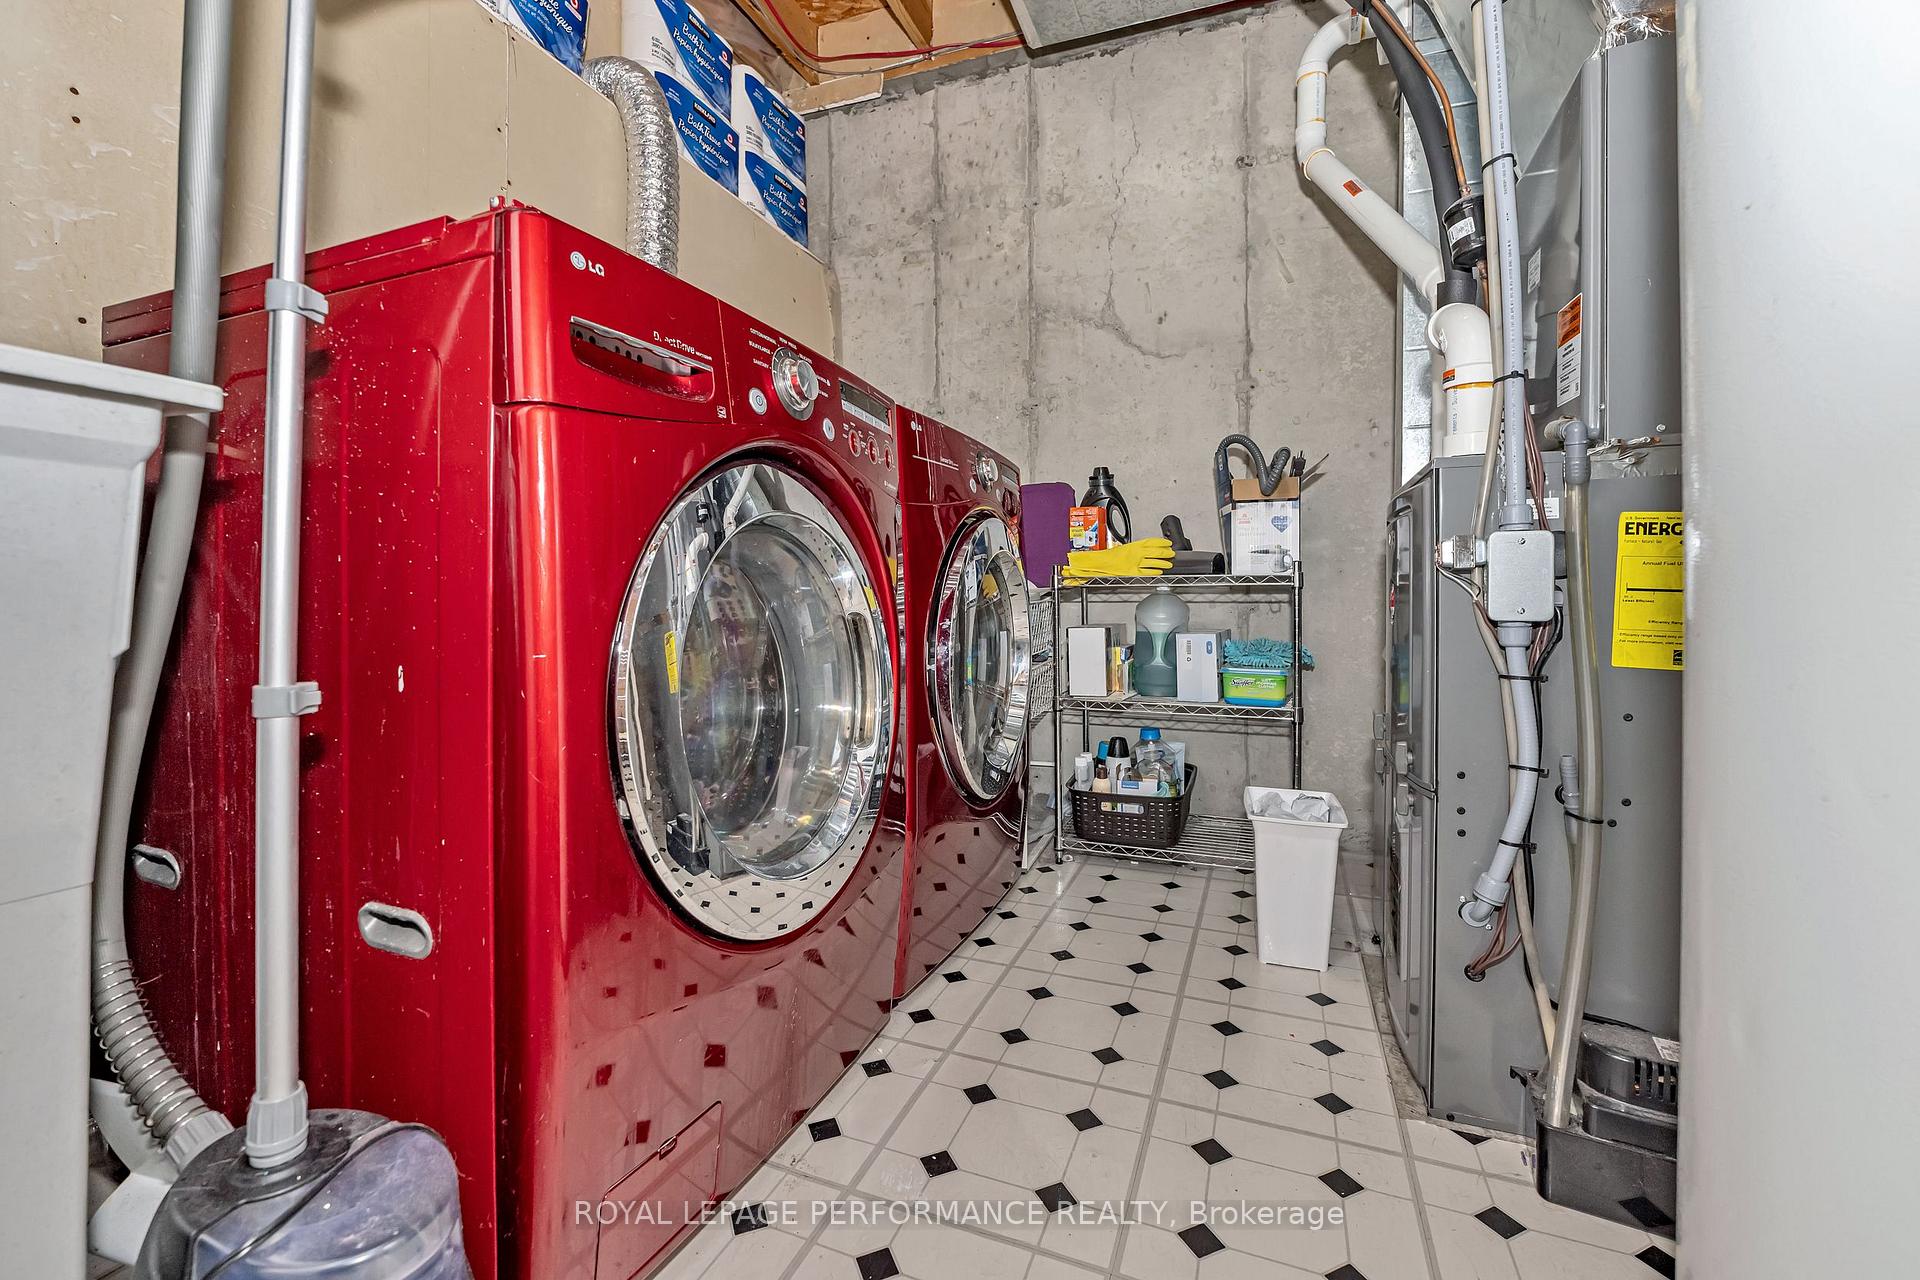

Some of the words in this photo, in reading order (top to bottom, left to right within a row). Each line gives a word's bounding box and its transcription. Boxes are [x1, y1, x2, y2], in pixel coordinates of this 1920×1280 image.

[673, 27, 693, 54] Papier
[682, 22, 699, 47] Bath
[678, 117, 699, 142] Papier
[698, 135, 730, 167] hygiénique
[687, 112, 704, 134] Bath
[703, 125, 722, 148] Tissue
[588, 259, 605, 277] LG
[1625, 521, 1683, 536] ENERG
[1231, 679, 1254, 687] Swiffer
